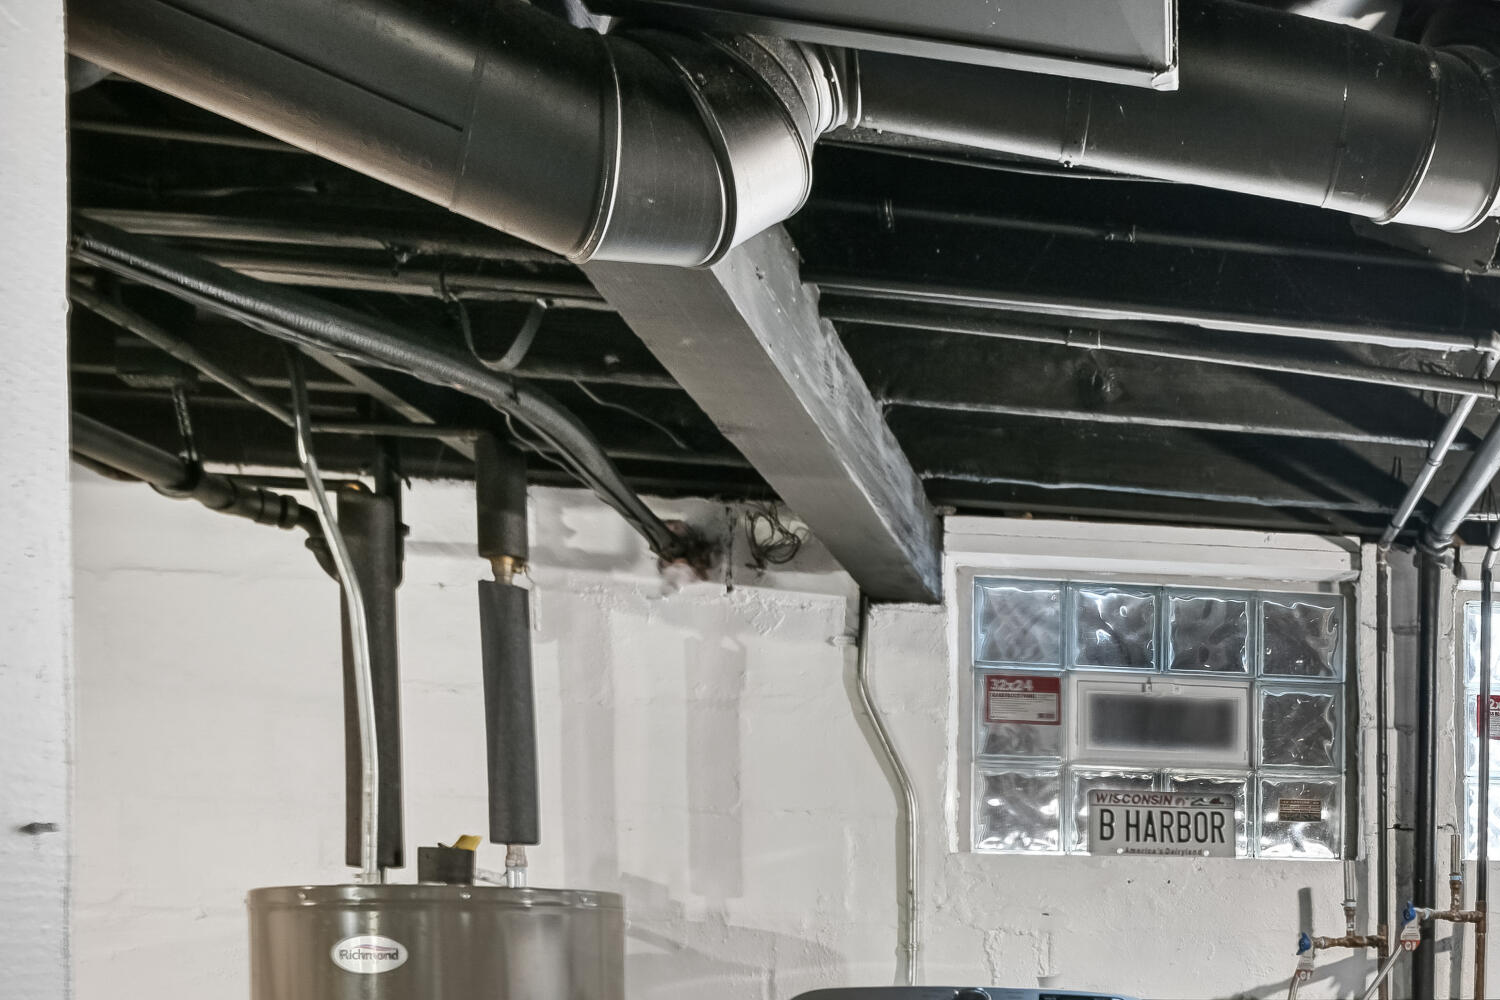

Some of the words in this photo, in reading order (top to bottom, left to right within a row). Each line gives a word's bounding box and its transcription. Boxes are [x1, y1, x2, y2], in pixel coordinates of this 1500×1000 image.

[990, 679, 1034, 692] 32x24
[1096, 793, 1173, 806] WISCONSIN
[1100, 808, 1115, 841] B
[1125, 809, 1225, 844] HARBOR
[1125, 847, 1162, 855] America's
[1165, 847, 1202, 857] Dairyland
[338, 947, 399, 961] Richmond
